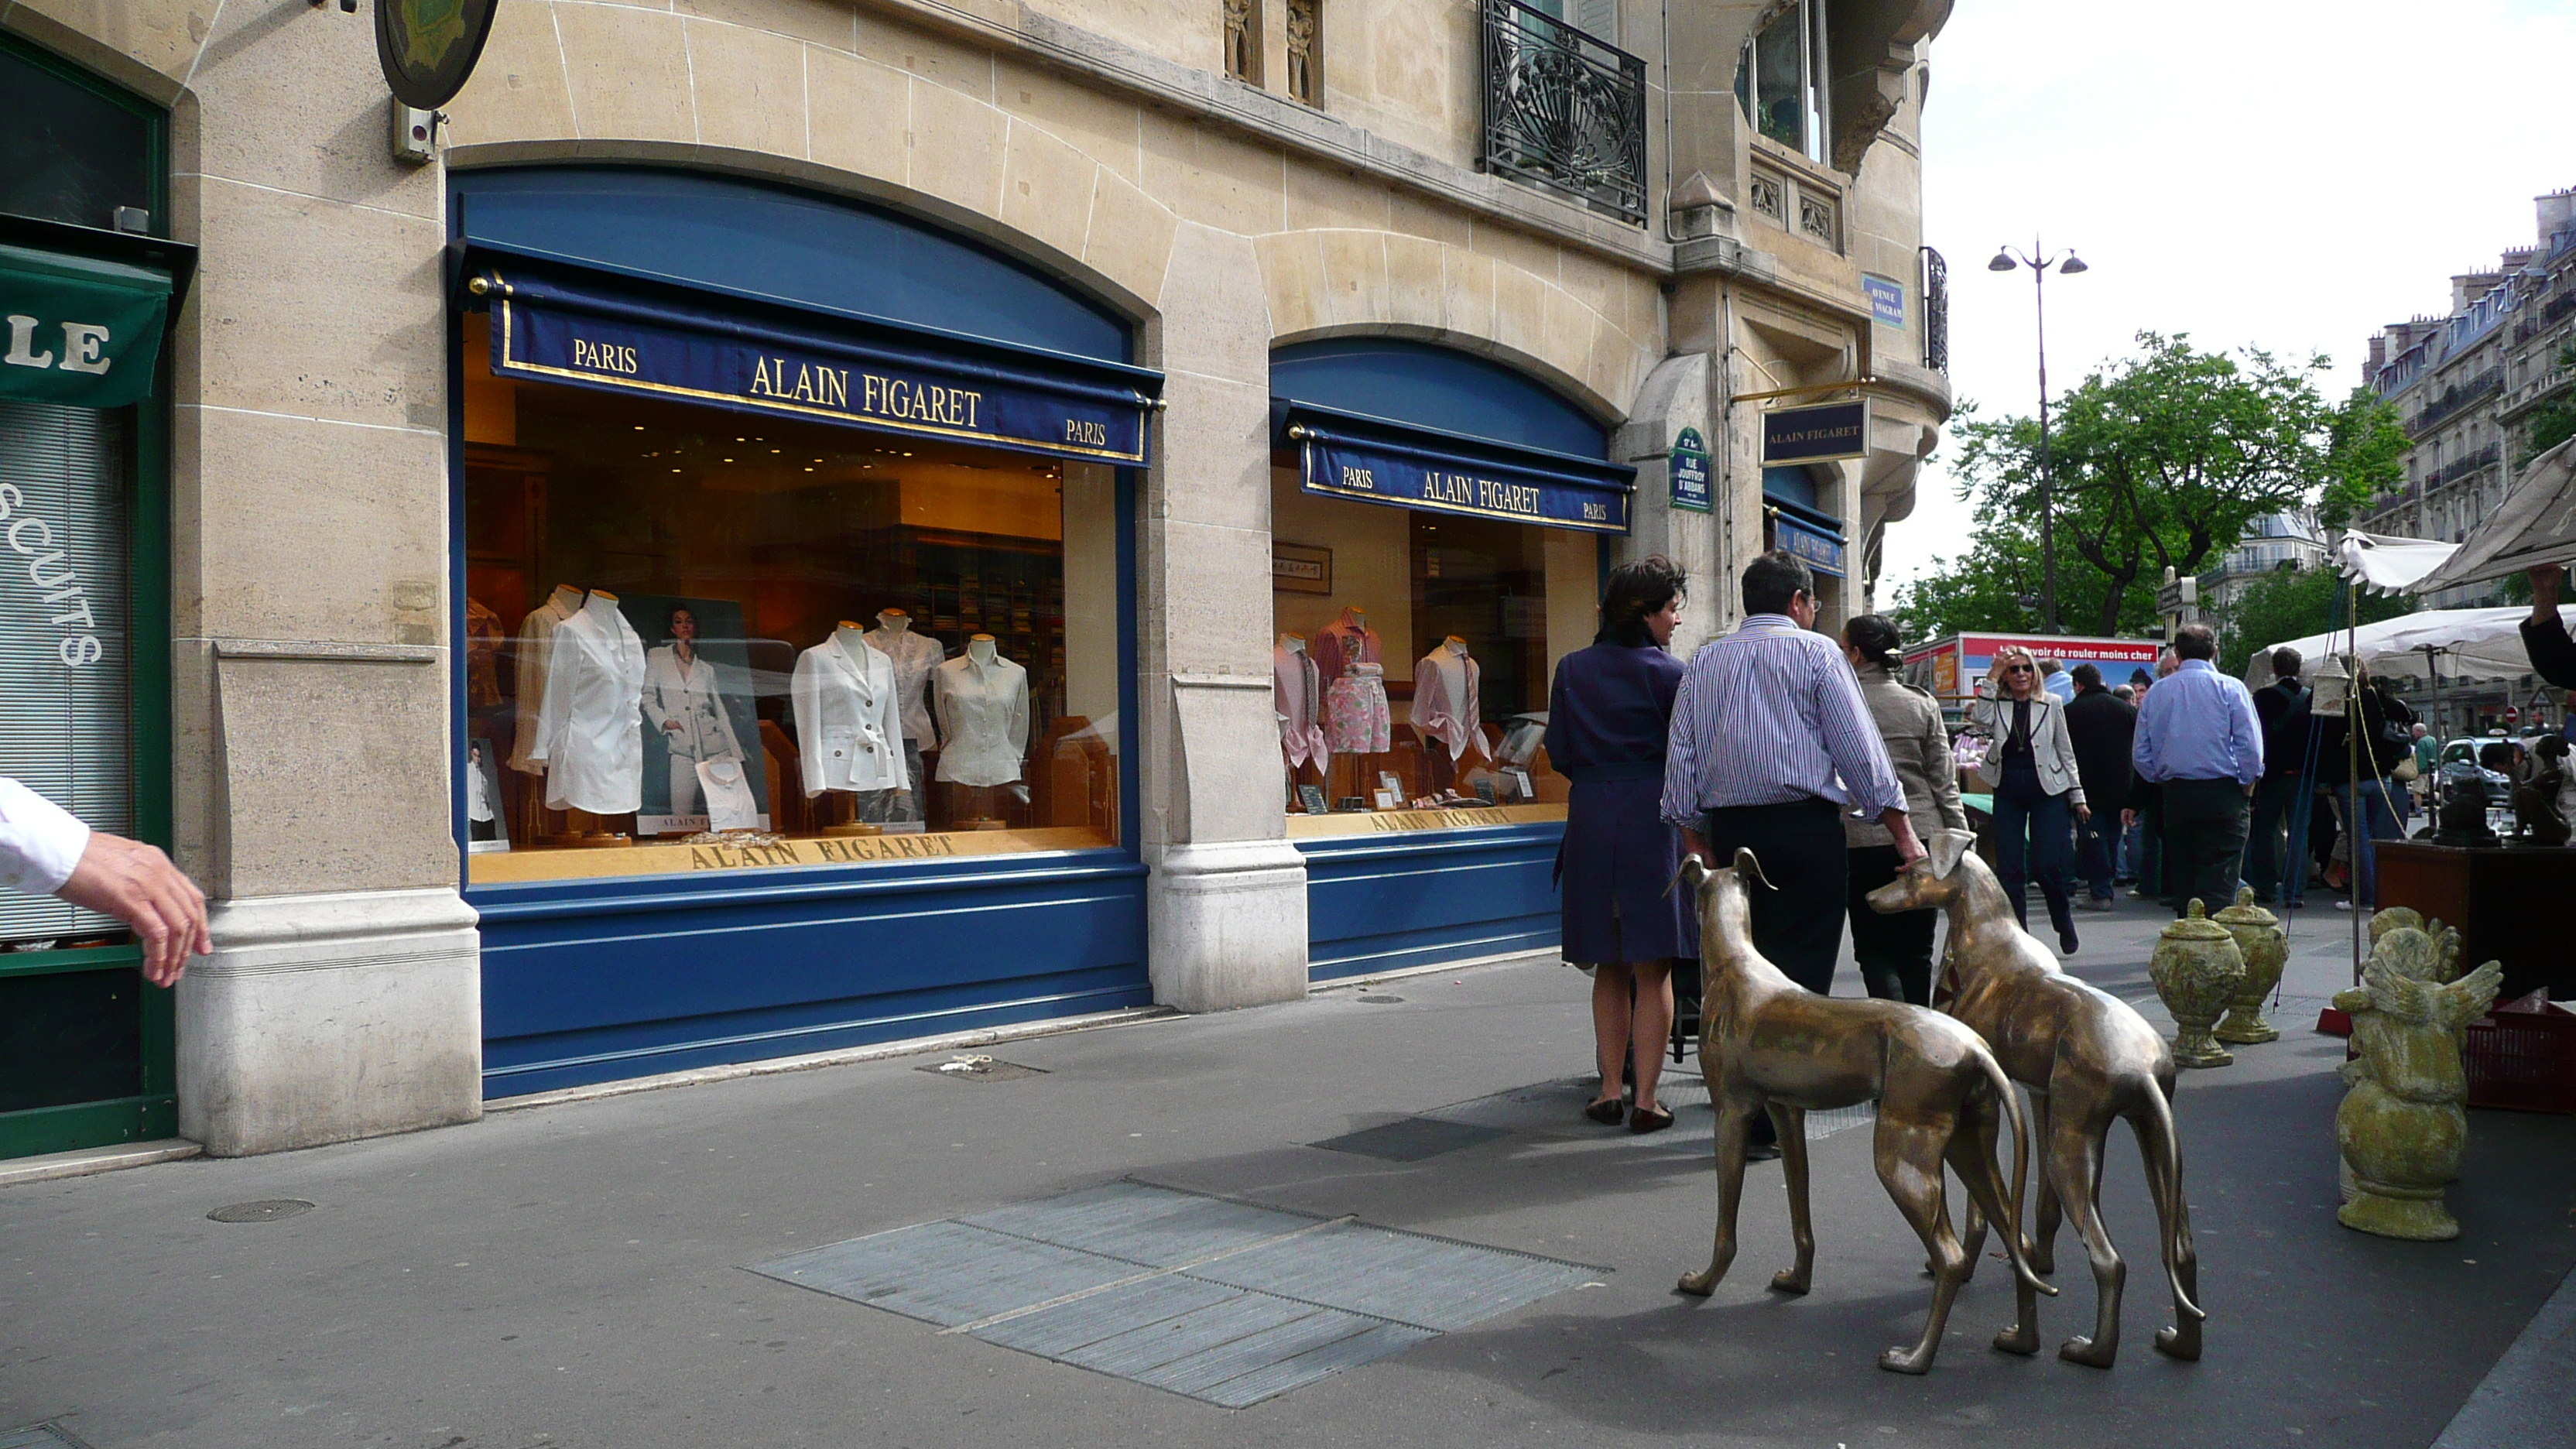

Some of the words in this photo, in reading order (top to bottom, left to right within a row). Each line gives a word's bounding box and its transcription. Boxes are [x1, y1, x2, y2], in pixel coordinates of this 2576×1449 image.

[1872, 288, 1896, 303] AVENUE
[1875, 302, 1902, 318] WAGRAM
[5, 315, 111, 375] LE
[574, 339, 637, 374] PARIS
[750, 355, 848, 408] ALAIN
[862, 374, 981, 427] FIGARET
[1066, 419, 1105, 446] PARIS
[1769, 431, 1804, 444] ALAIN
[1807, 425, 1859, 440] FIGARET
[1686, 457, 1697, 470] RUE
[1342, 465, 1373, 489] PARIS
[1678, 468, 1705, 482] JOUFFROY
[1423, 471, 1472, 504] ALAIN
[1478, 480, 1540, 514] FIGARET
[1583, 502, 1607, 520] PARIS
[0, 483, 102, 666] SCUITS
[2054, 647, 2066, 657] de
[2068, 648, 2098, 658] rouler
[2099, 649, 2129, 659] moins
[2131, 650, 2153, 660] cher
[662, 818, 696, 827] ALAIN
[1370, 813, 1430, 831] ALAIN
[1433, 809, 1510, 827] FIGARET
[691, 842, 800, 869] ALAIN
[814, 834, 957, 862] FIGARET
